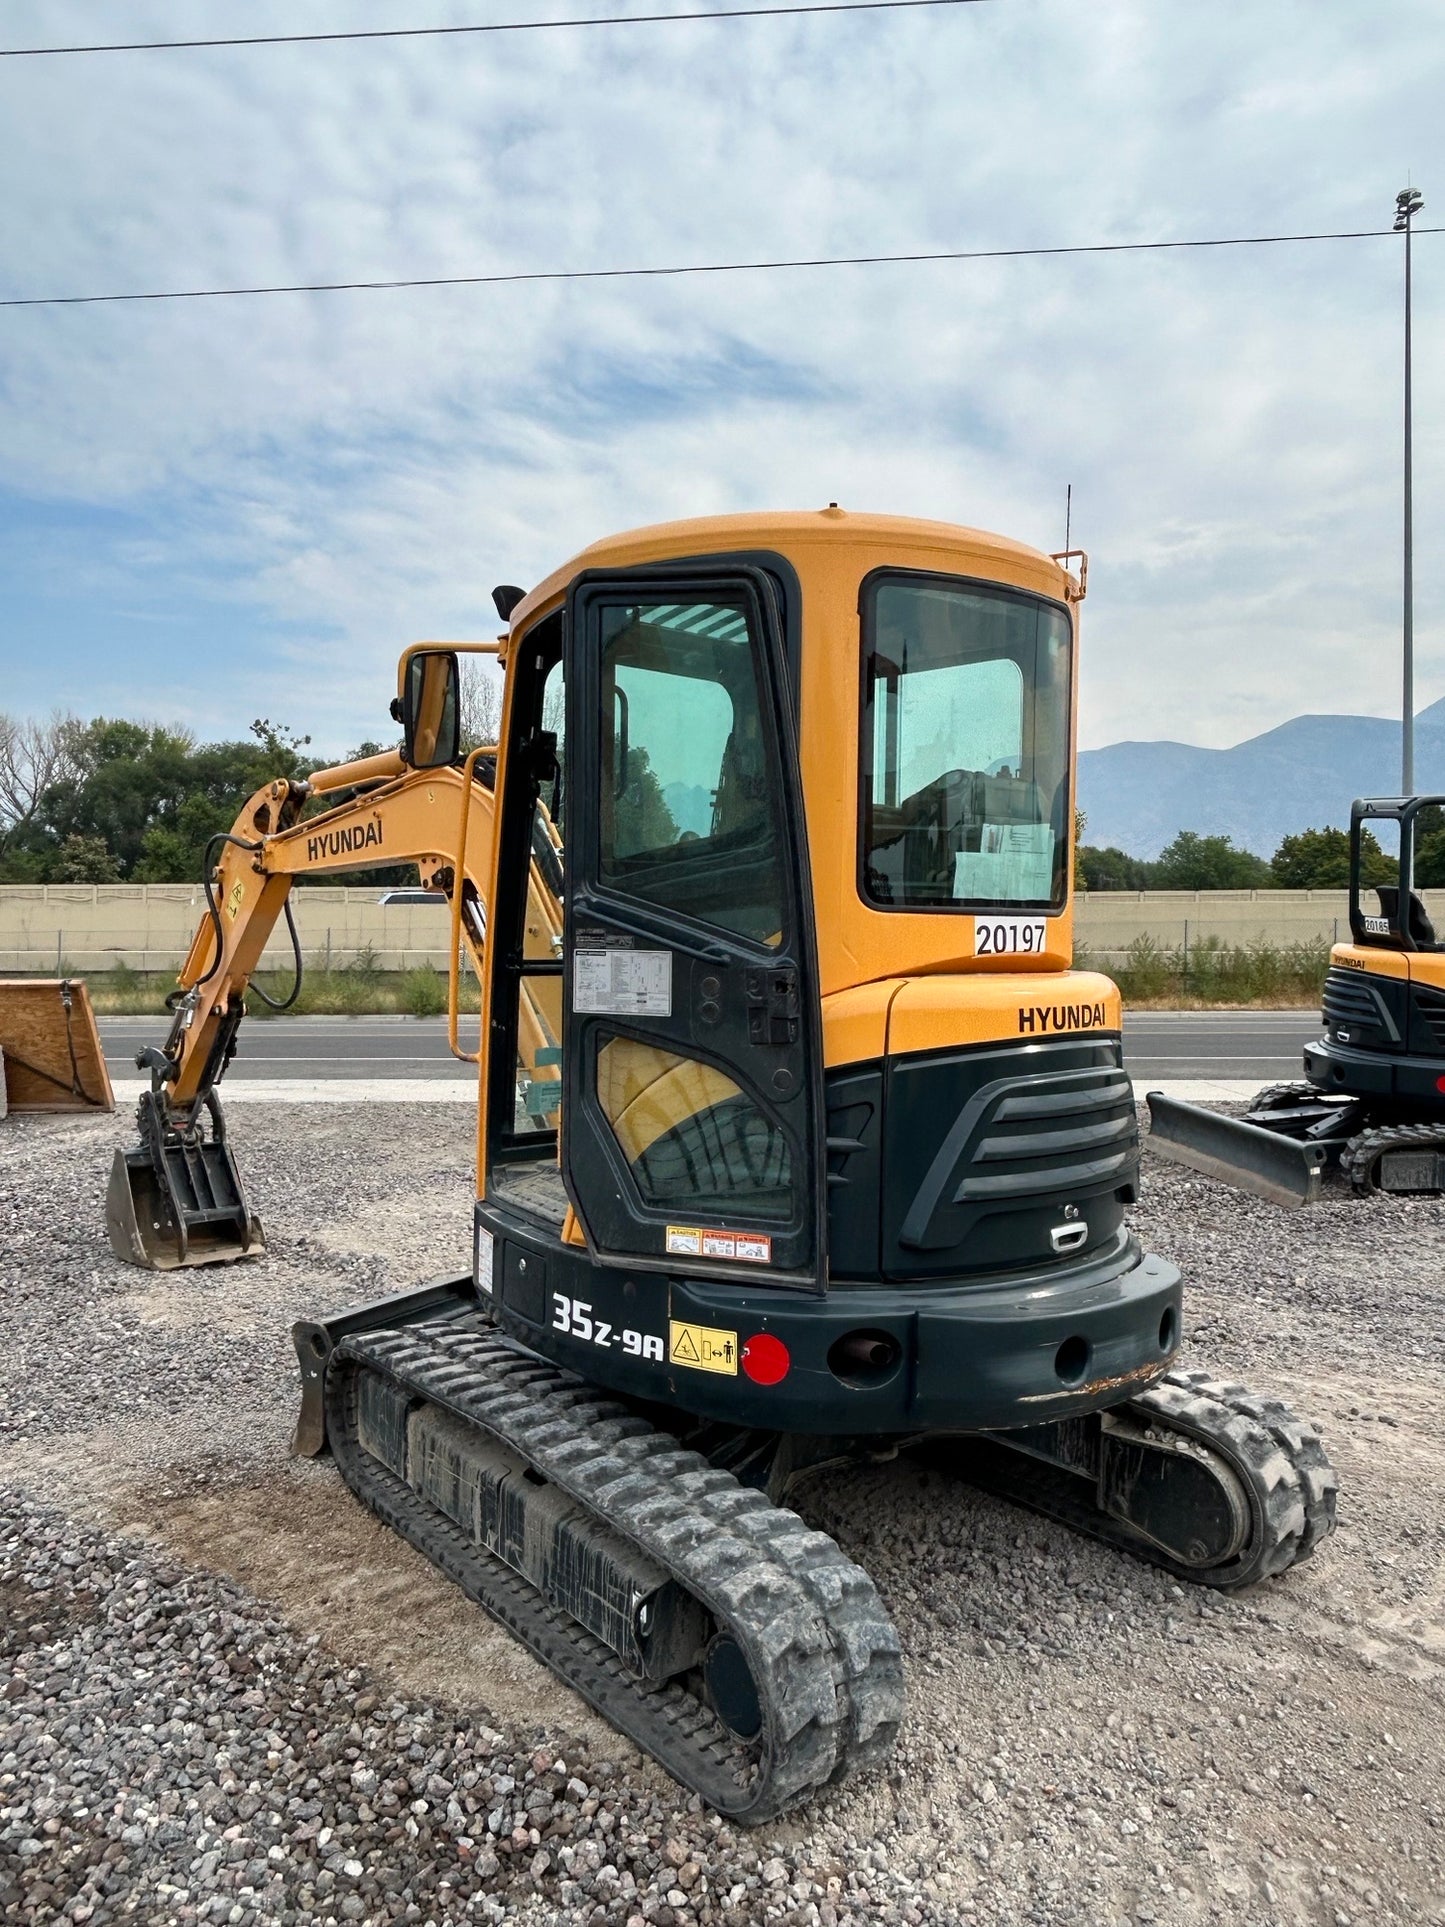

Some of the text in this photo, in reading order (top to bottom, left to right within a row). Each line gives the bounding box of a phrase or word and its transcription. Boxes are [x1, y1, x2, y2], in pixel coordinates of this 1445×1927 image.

[307, 819, 383, 861] HYUNDAI
[976, 924, 1045, 955] 20197
[1365, 919, 1389, 933] 20185
[1018, 1002, 1105, 1033] HYUNDAI
